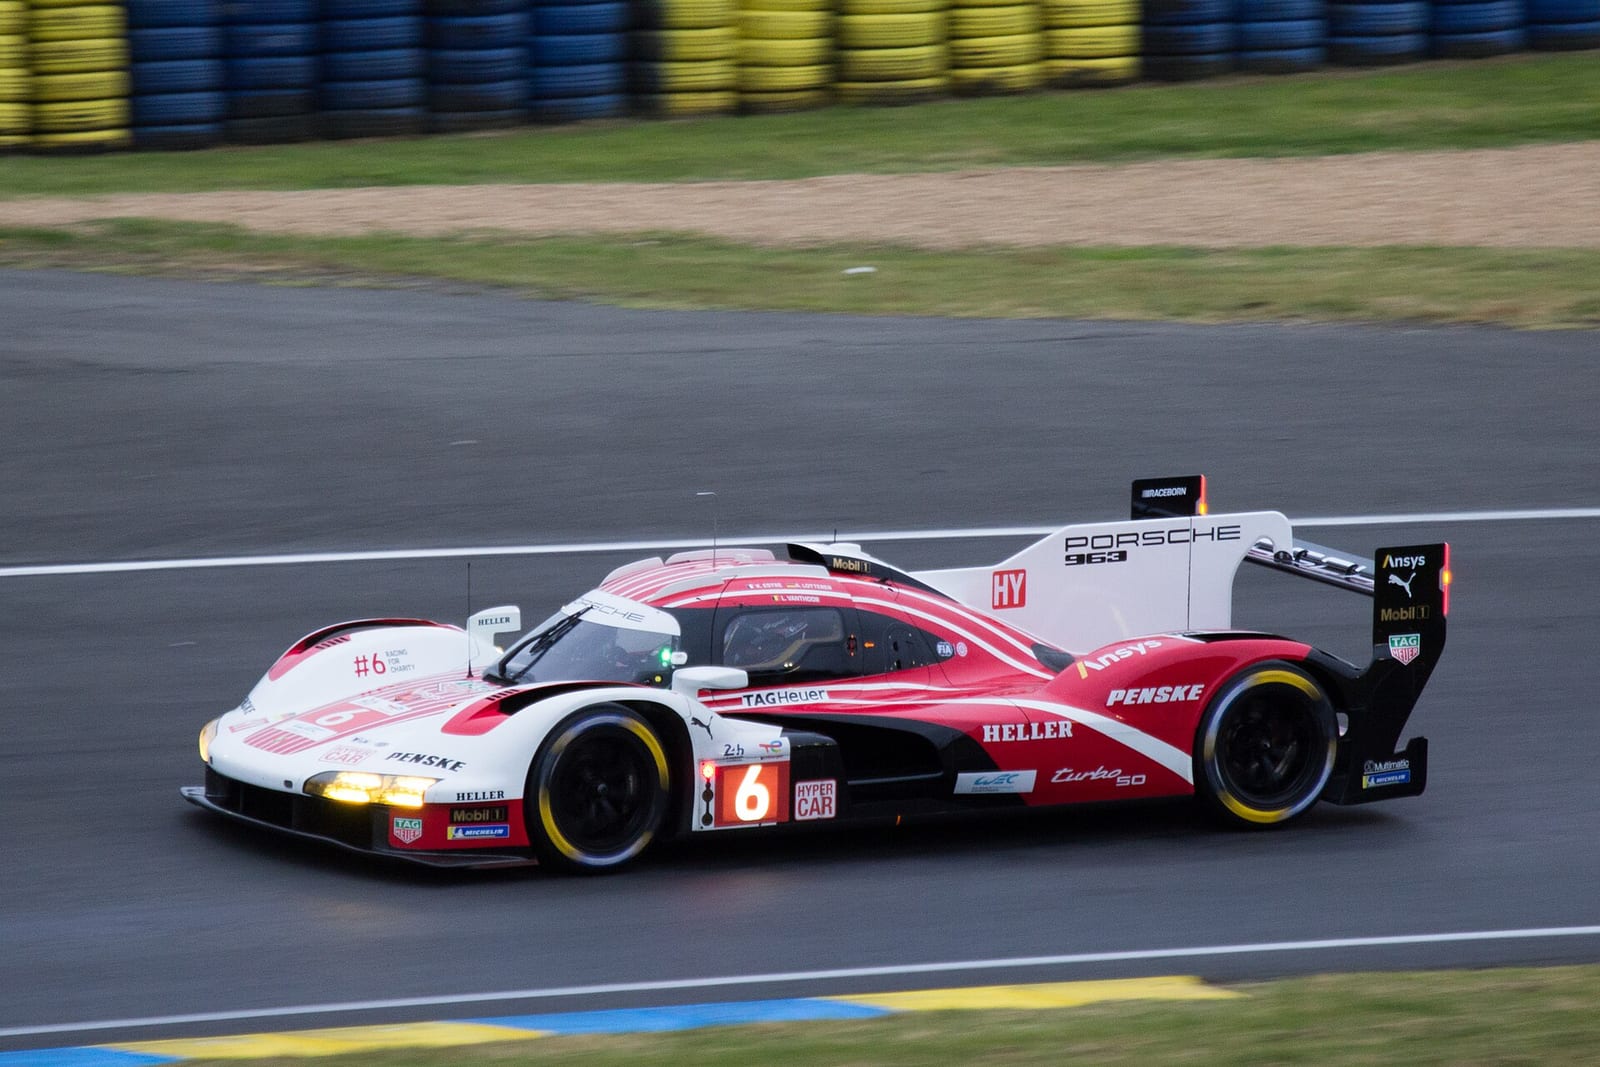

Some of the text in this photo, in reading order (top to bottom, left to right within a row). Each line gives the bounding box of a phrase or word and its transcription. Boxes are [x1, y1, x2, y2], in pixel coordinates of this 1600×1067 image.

[1064, 525, 1241, 552] PORSCHE
[833, 557, 861, 572] Mobil
[1064, 551, 1127, 566] 963
[1382, 554, 1426, 570] Ansys
[993, 573, 1025, 607] HY
[478, 616, 511, 626] HELLER
[1380, 606, 1415, 621] Mobil
[1391, 636, 1418, 647] TAG
[354, 652, 386, 677] #6
[1076, 640, 1162, 680] Ansys
[1106, 684, 1205, 707] PENSKE
[982, 720, 1073, 743] HELLER
[384, 752, 467, 773] PENSKE
[1051, 765, 1146, 787] turbo 50
[456, 790, 505, 802] HELLER
[735, 764, 770, 821] 6
[797, 782, 833, 797] HYPER
[797, 796, 833, 817] CAR
[396, 819, 420, 829] TAG
[453, 809, 490, 823] Mobil
